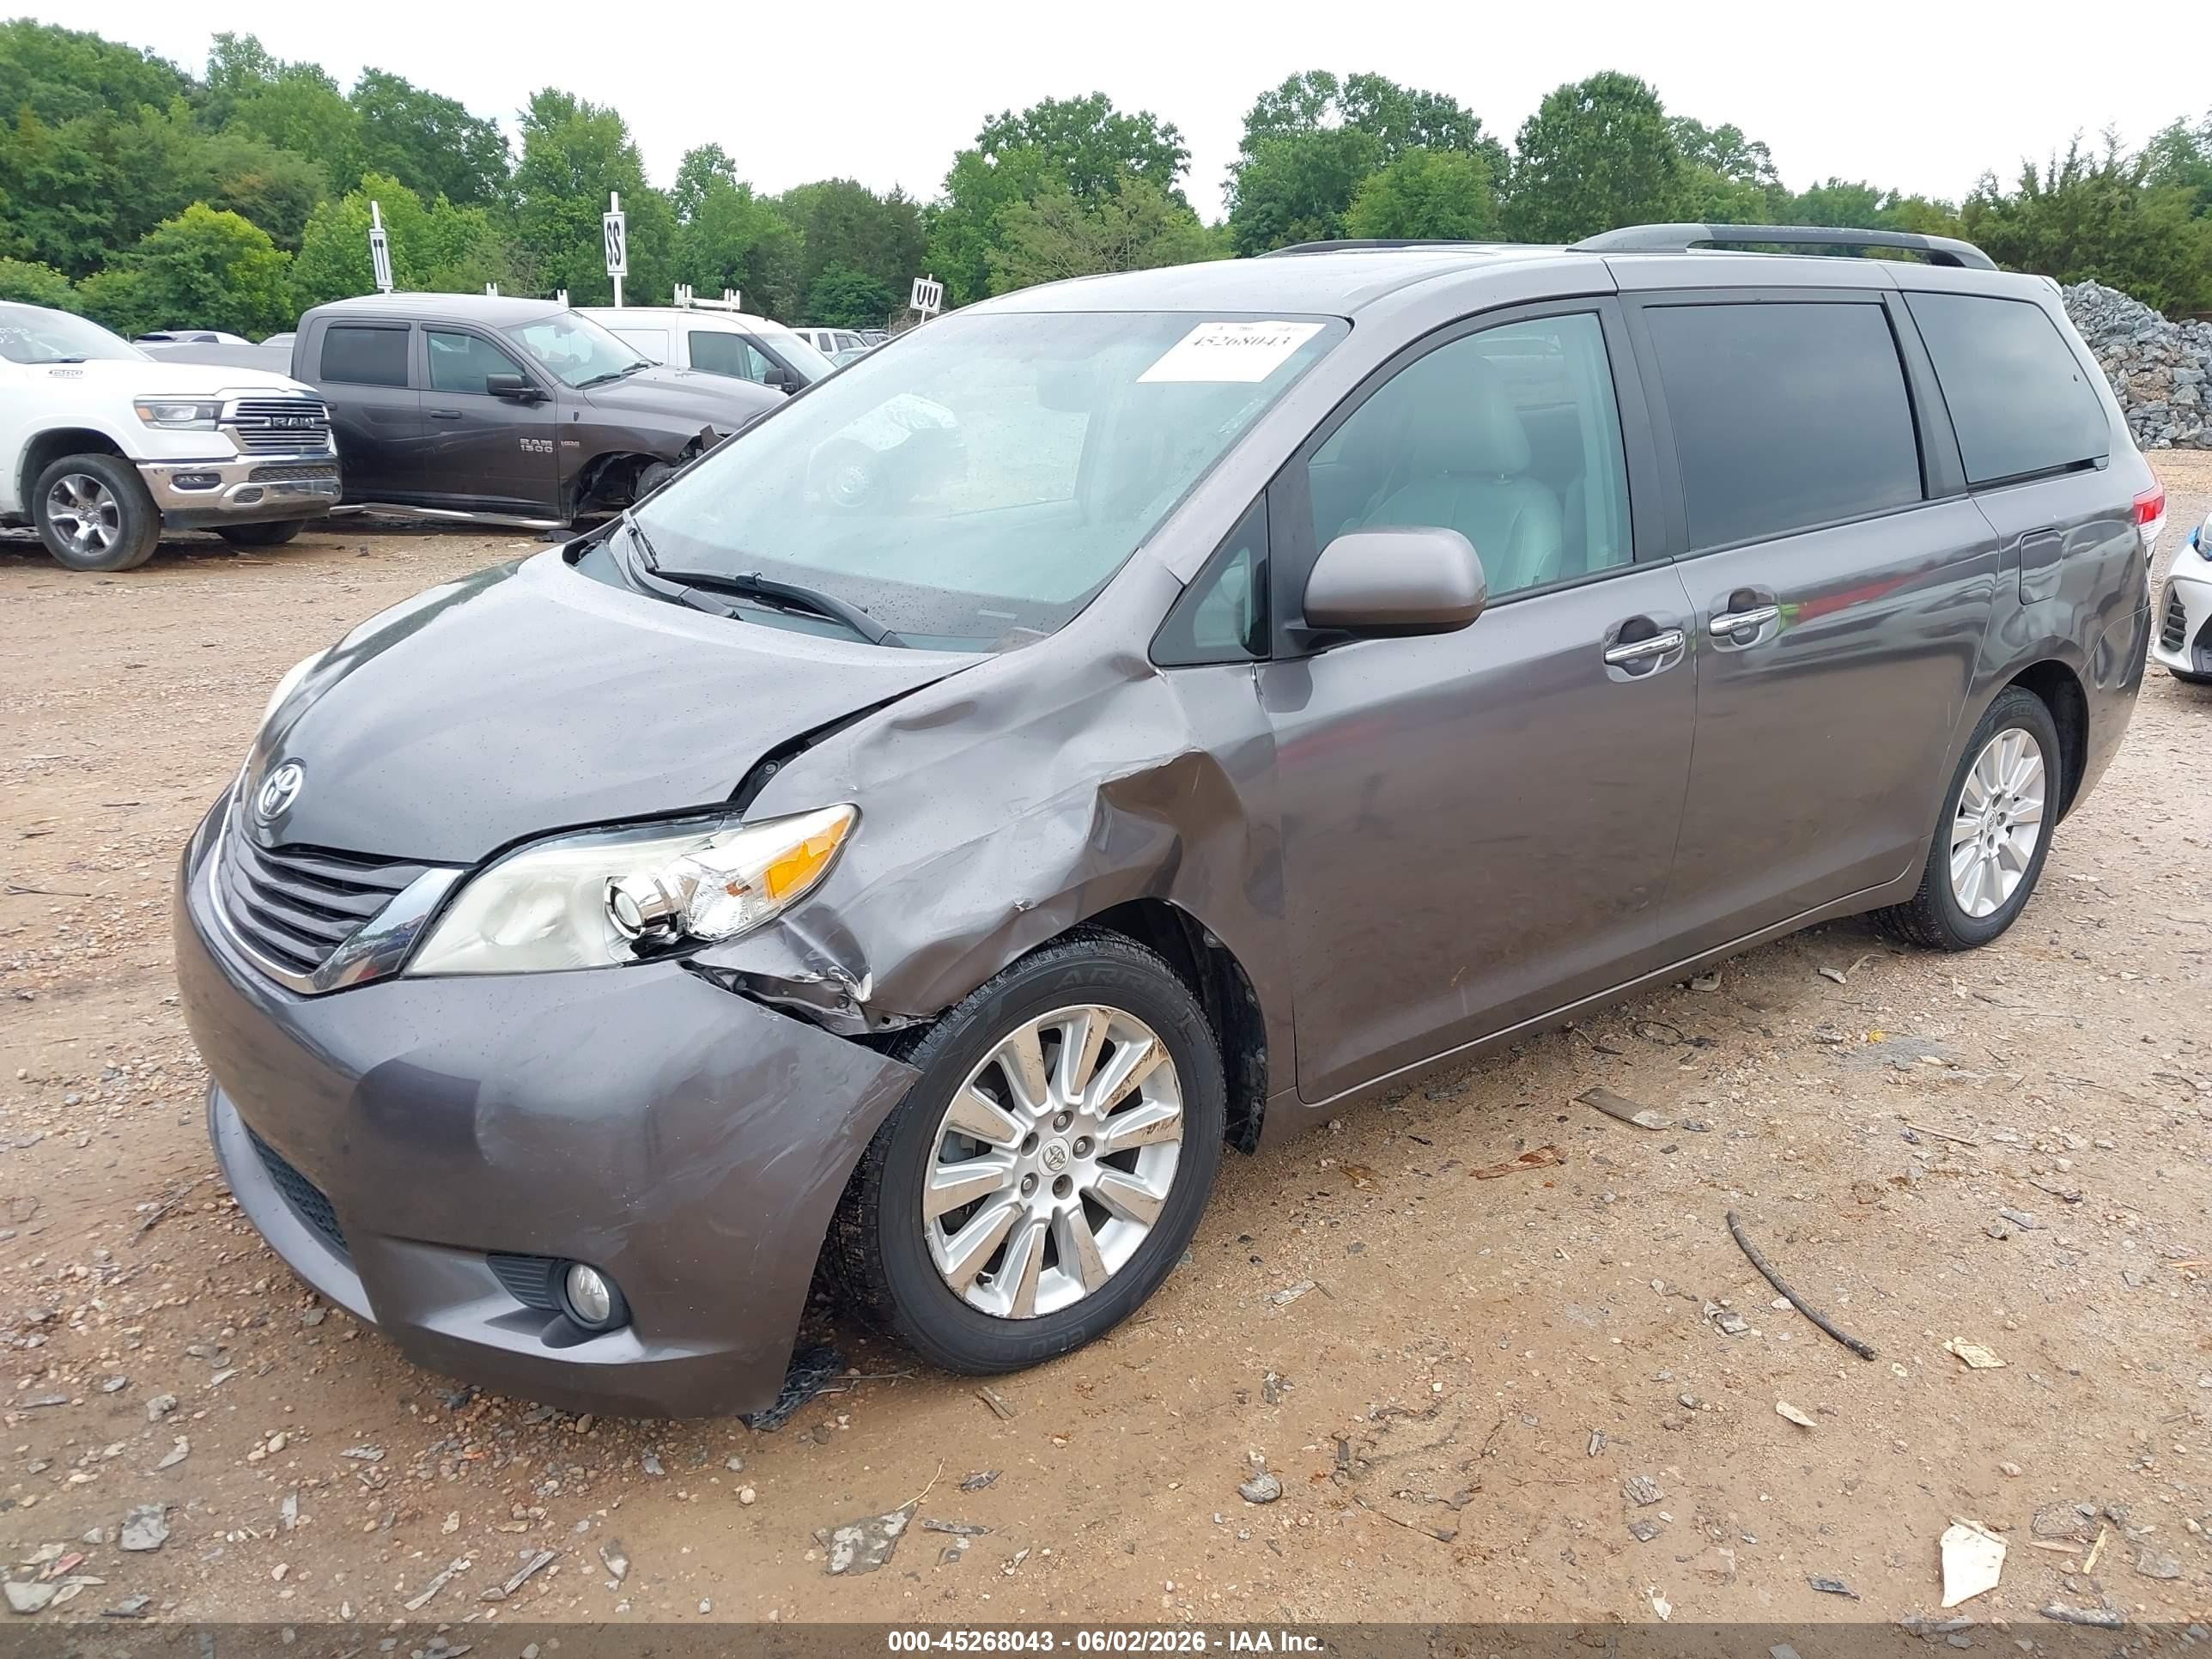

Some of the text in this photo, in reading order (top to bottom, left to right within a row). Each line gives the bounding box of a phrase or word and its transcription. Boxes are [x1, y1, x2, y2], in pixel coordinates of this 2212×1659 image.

[606, 220, 622, 266] SS
[916, 284, 939, 308] UU
[520, 438, 553, 447] RAM
